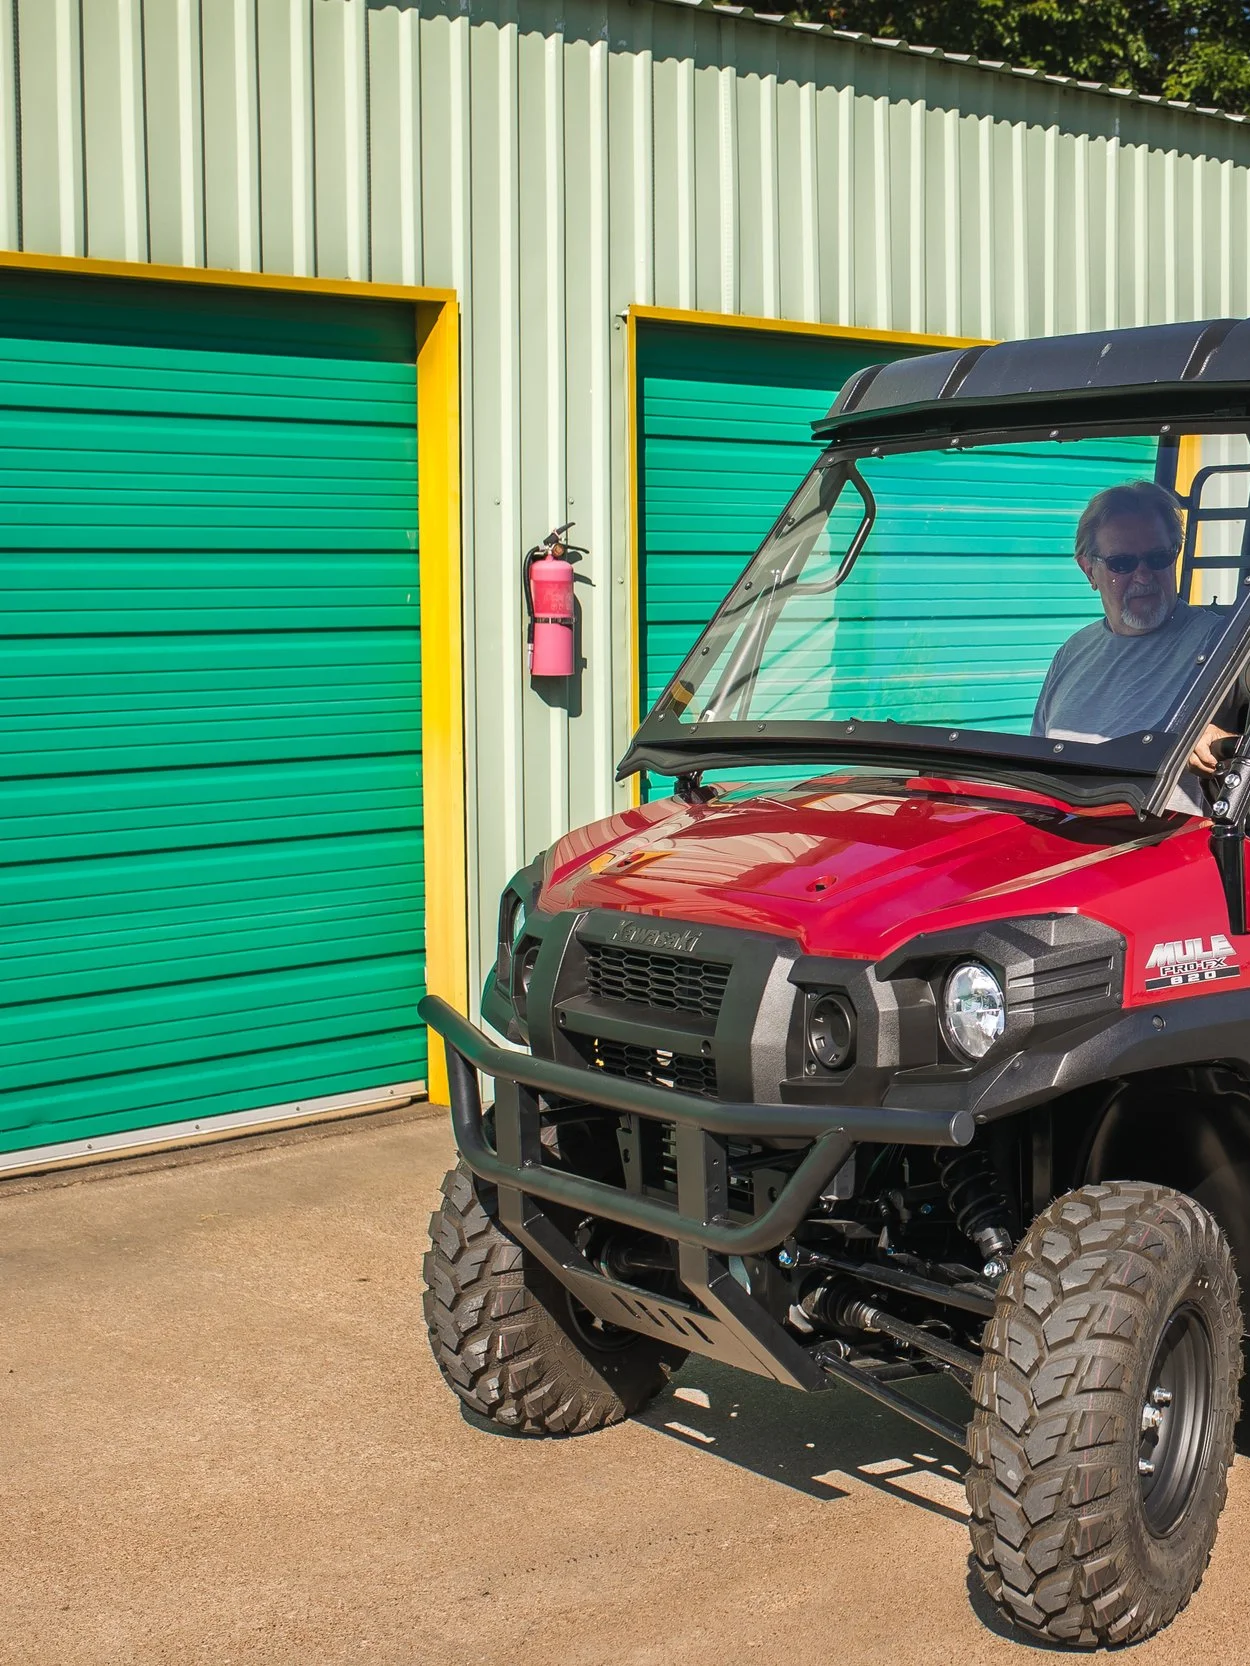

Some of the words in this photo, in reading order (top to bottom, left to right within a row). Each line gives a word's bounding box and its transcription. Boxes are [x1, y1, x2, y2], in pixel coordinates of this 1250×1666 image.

[612, 920, 703, 952] Kawasaki
[1145, 934, 1237, 969] MULE
[1160, 956, 1228, 976] PRO-FX
